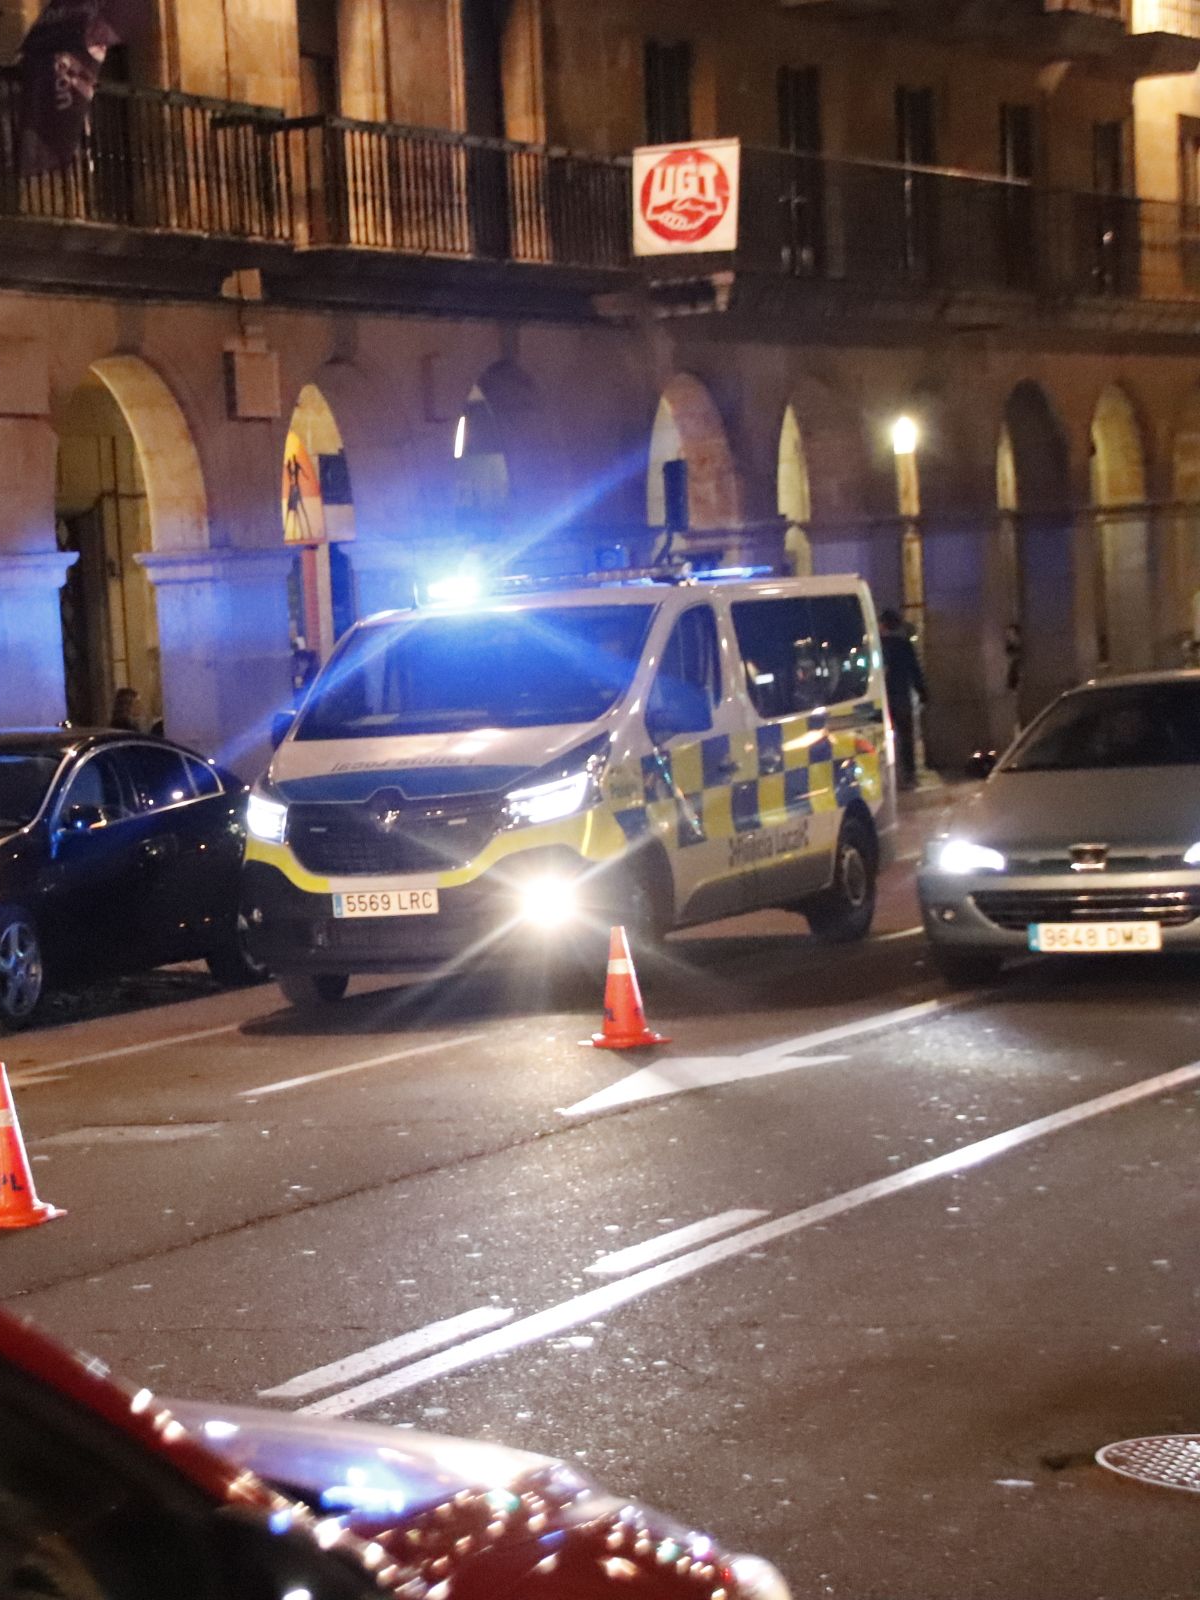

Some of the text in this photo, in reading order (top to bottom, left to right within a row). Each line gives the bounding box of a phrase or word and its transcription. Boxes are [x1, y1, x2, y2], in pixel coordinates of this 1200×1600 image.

[652, 161, 720, 204] UGT
[345, 891, 433, 913] 5569 LRC
